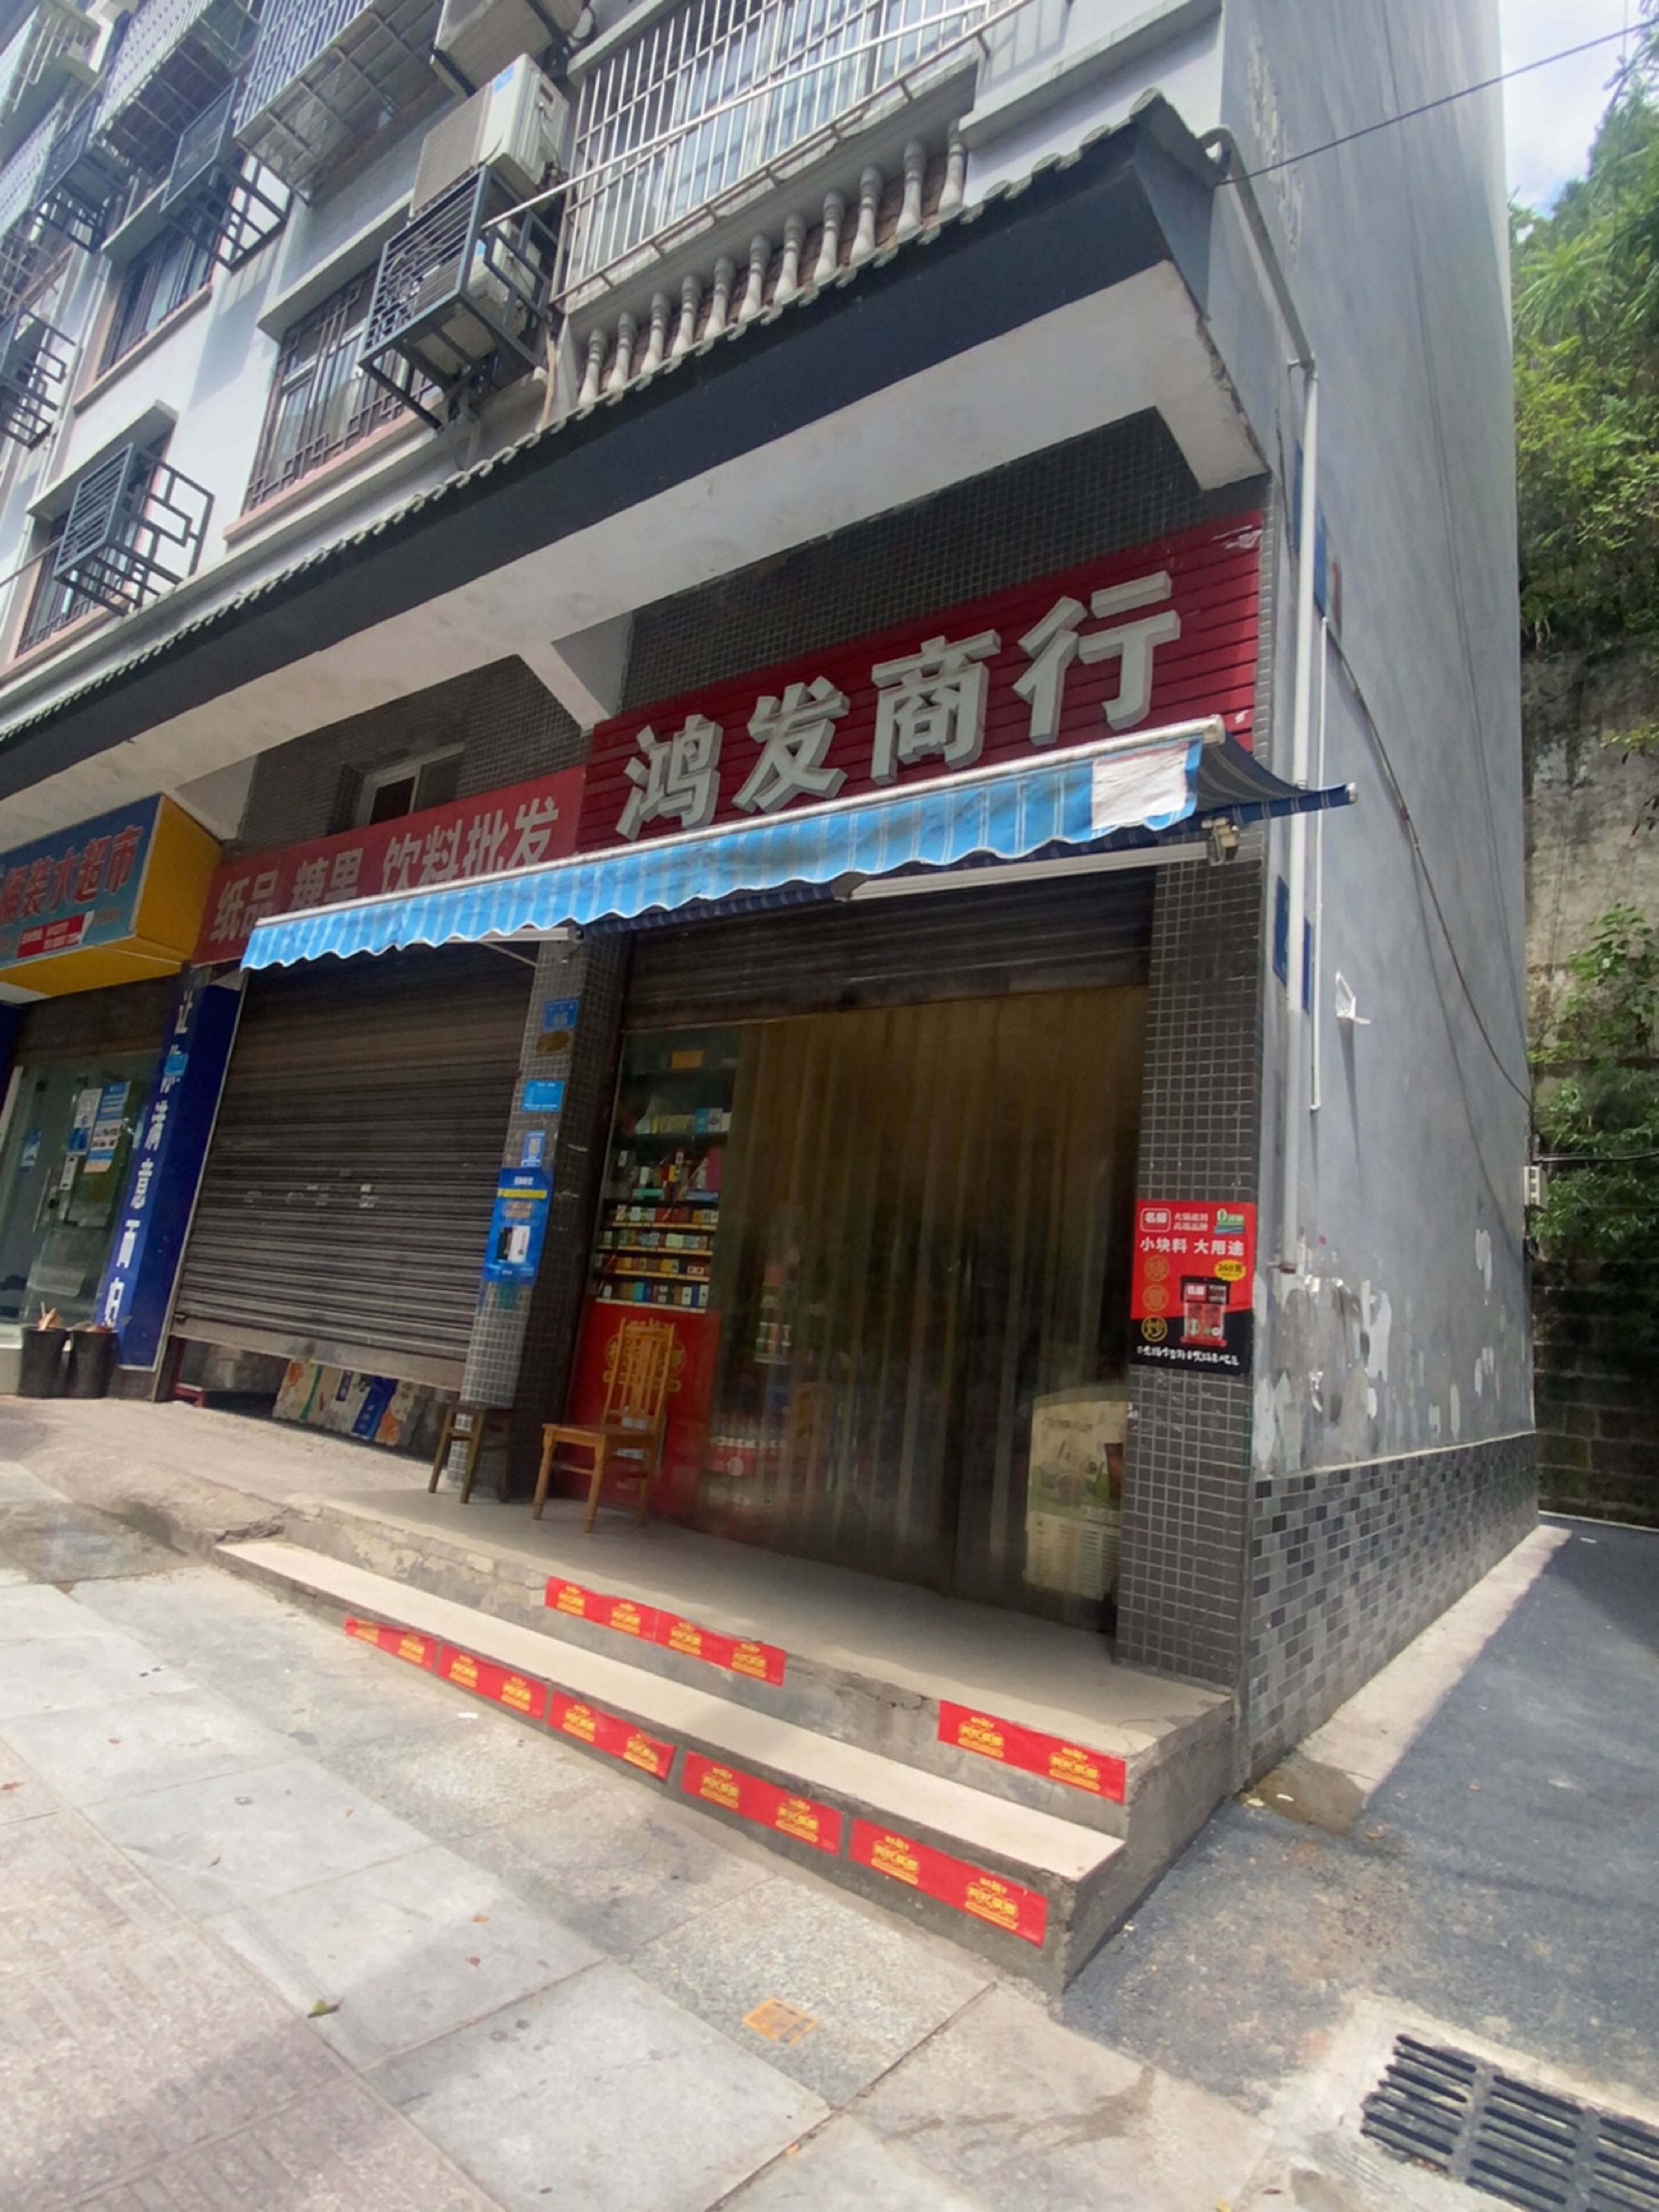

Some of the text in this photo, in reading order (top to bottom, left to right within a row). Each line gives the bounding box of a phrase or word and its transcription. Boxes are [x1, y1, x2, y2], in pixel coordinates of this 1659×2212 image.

[614, 571, 1182, 841] 鸿发商行
[209, 869, 278, 943] 纸品
[381, 796, 559, 891] 饮料批发
